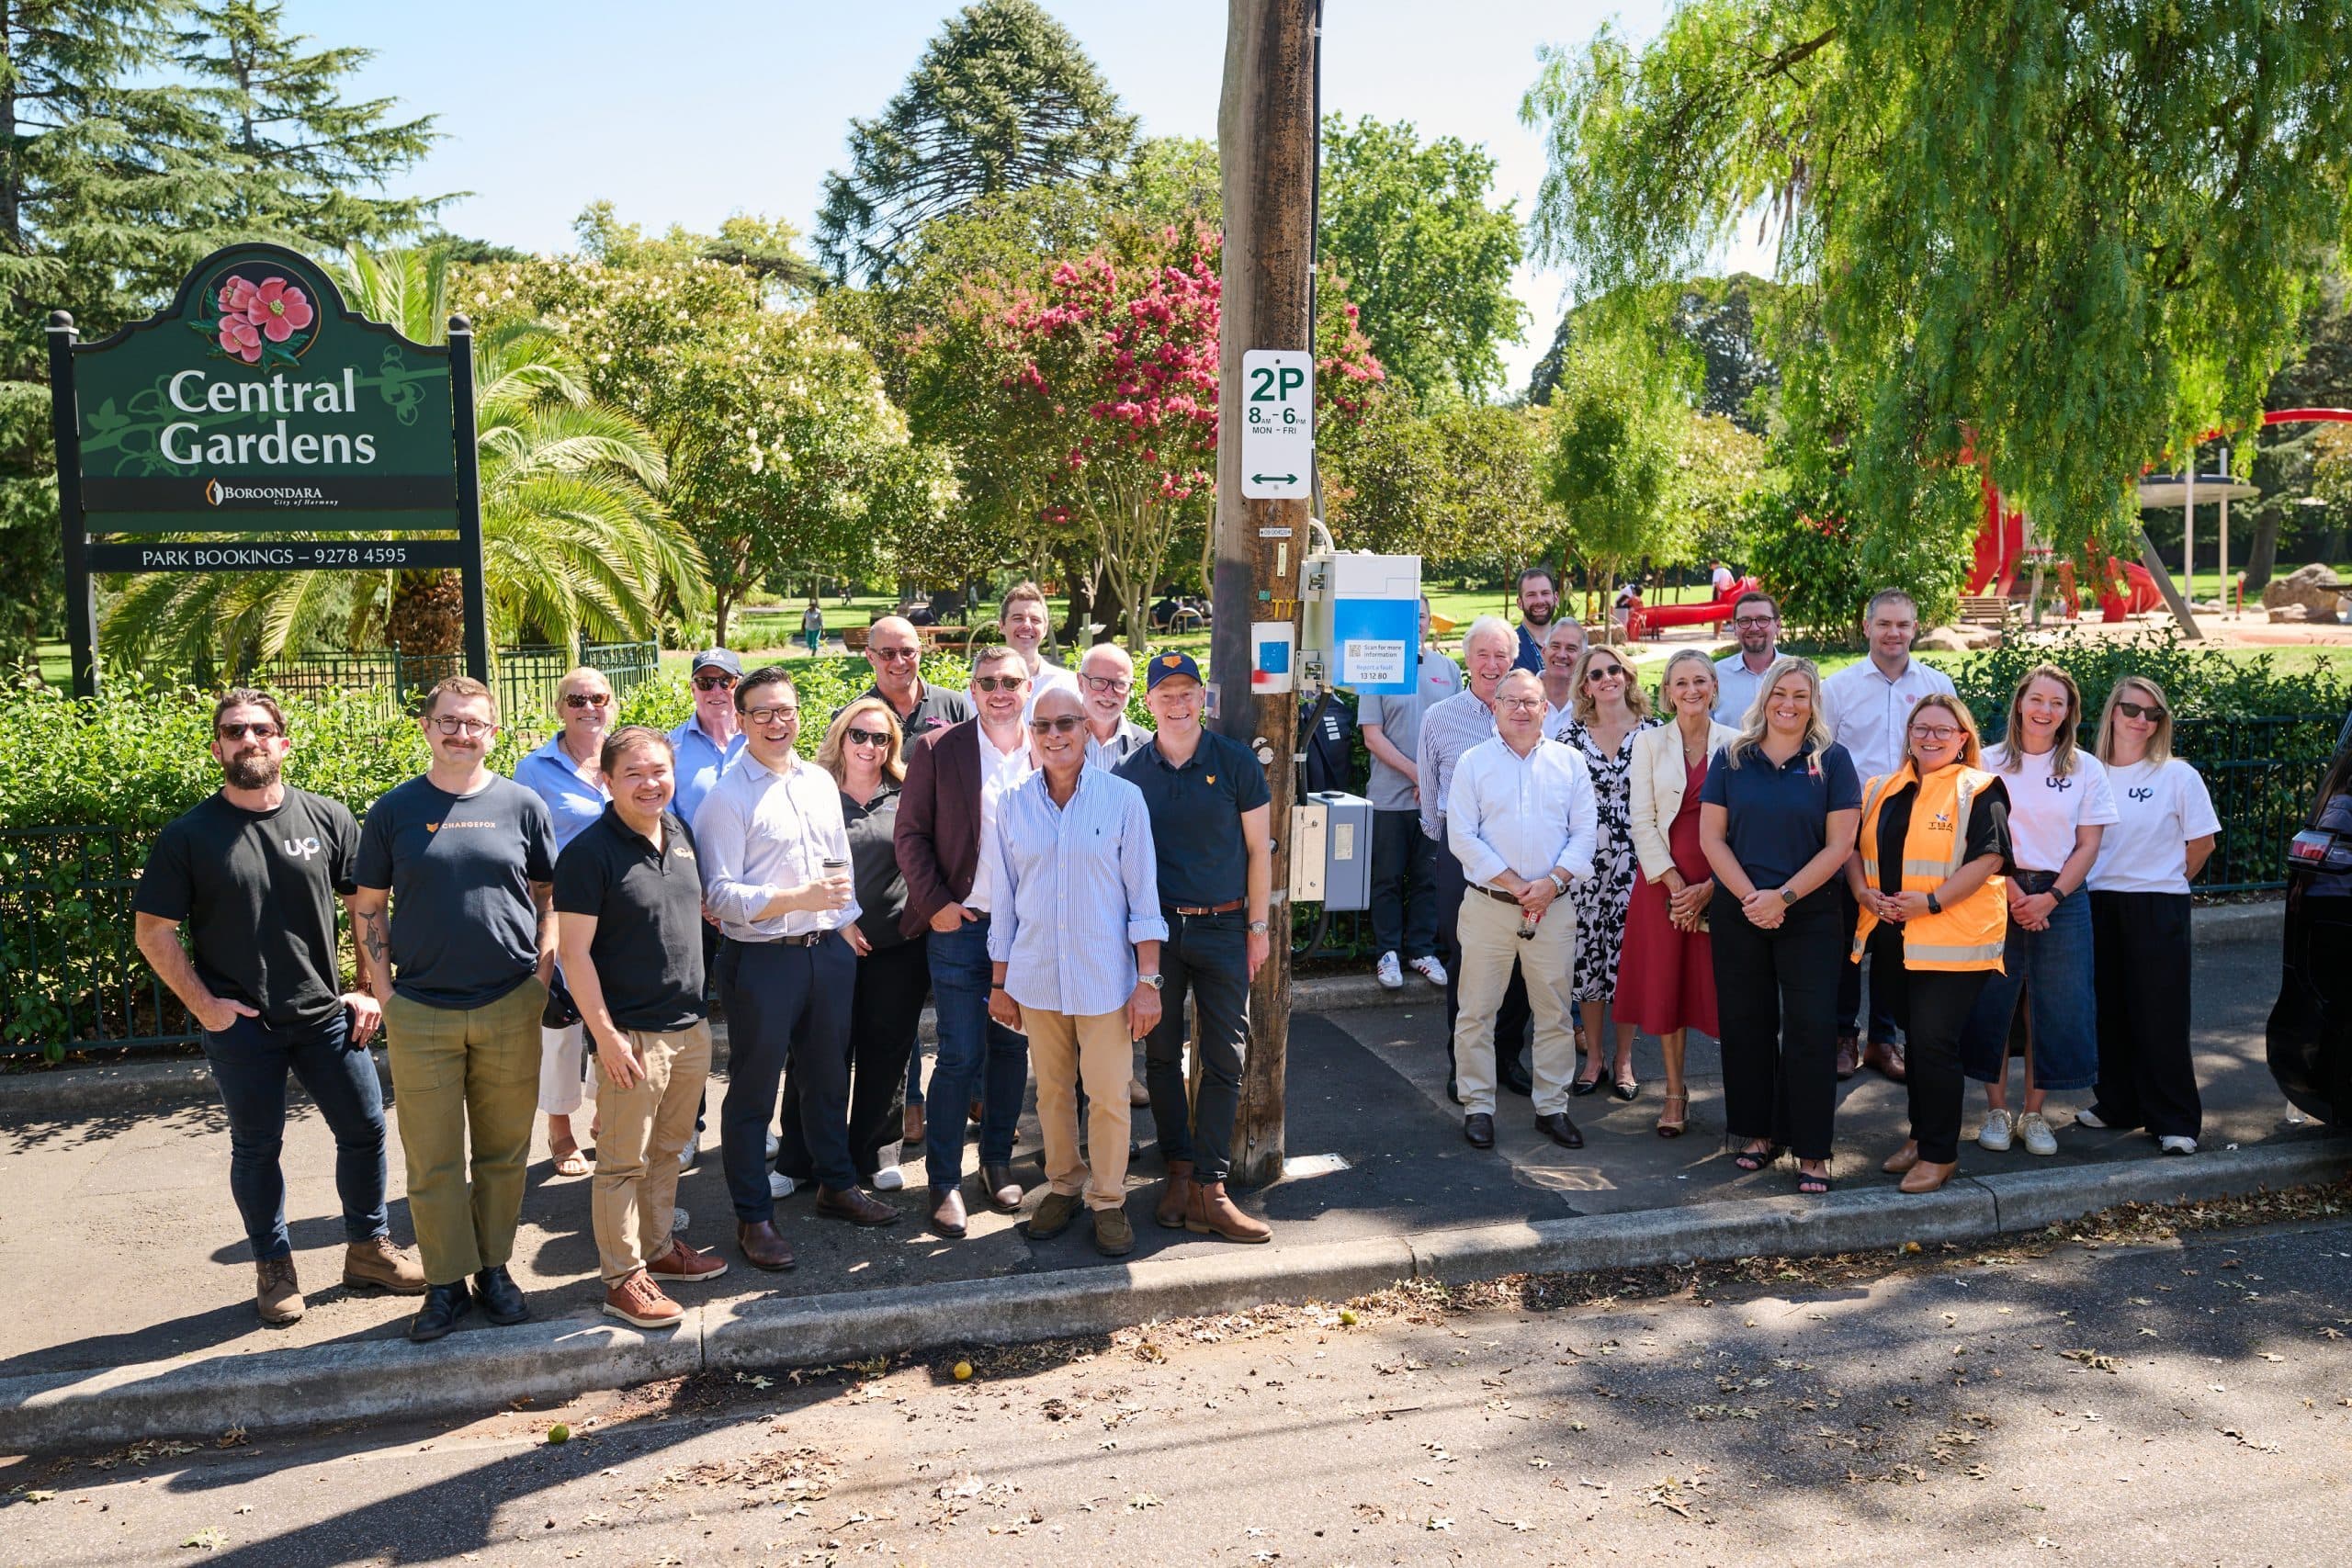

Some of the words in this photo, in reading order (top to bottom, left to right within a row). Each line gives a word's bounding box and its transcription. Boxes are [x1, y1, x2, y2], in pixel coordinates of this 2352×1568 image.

[169, 367, 356, 412] Central
[1250, 367, 1305, 401] 2P
[160, 419, 376, 465] Gardens
[224, 487, 322, 499] BOROONDARA
[142, 550, 189, 565] PARK
[195, 549, 294, 565] BOOKINGS
[314, 548, 358, 563] 9278
[364, 547, 406, 562] 4595
[441, 821, 496, 829] CHARGEFOX
[284, 837, 321, 861] up
